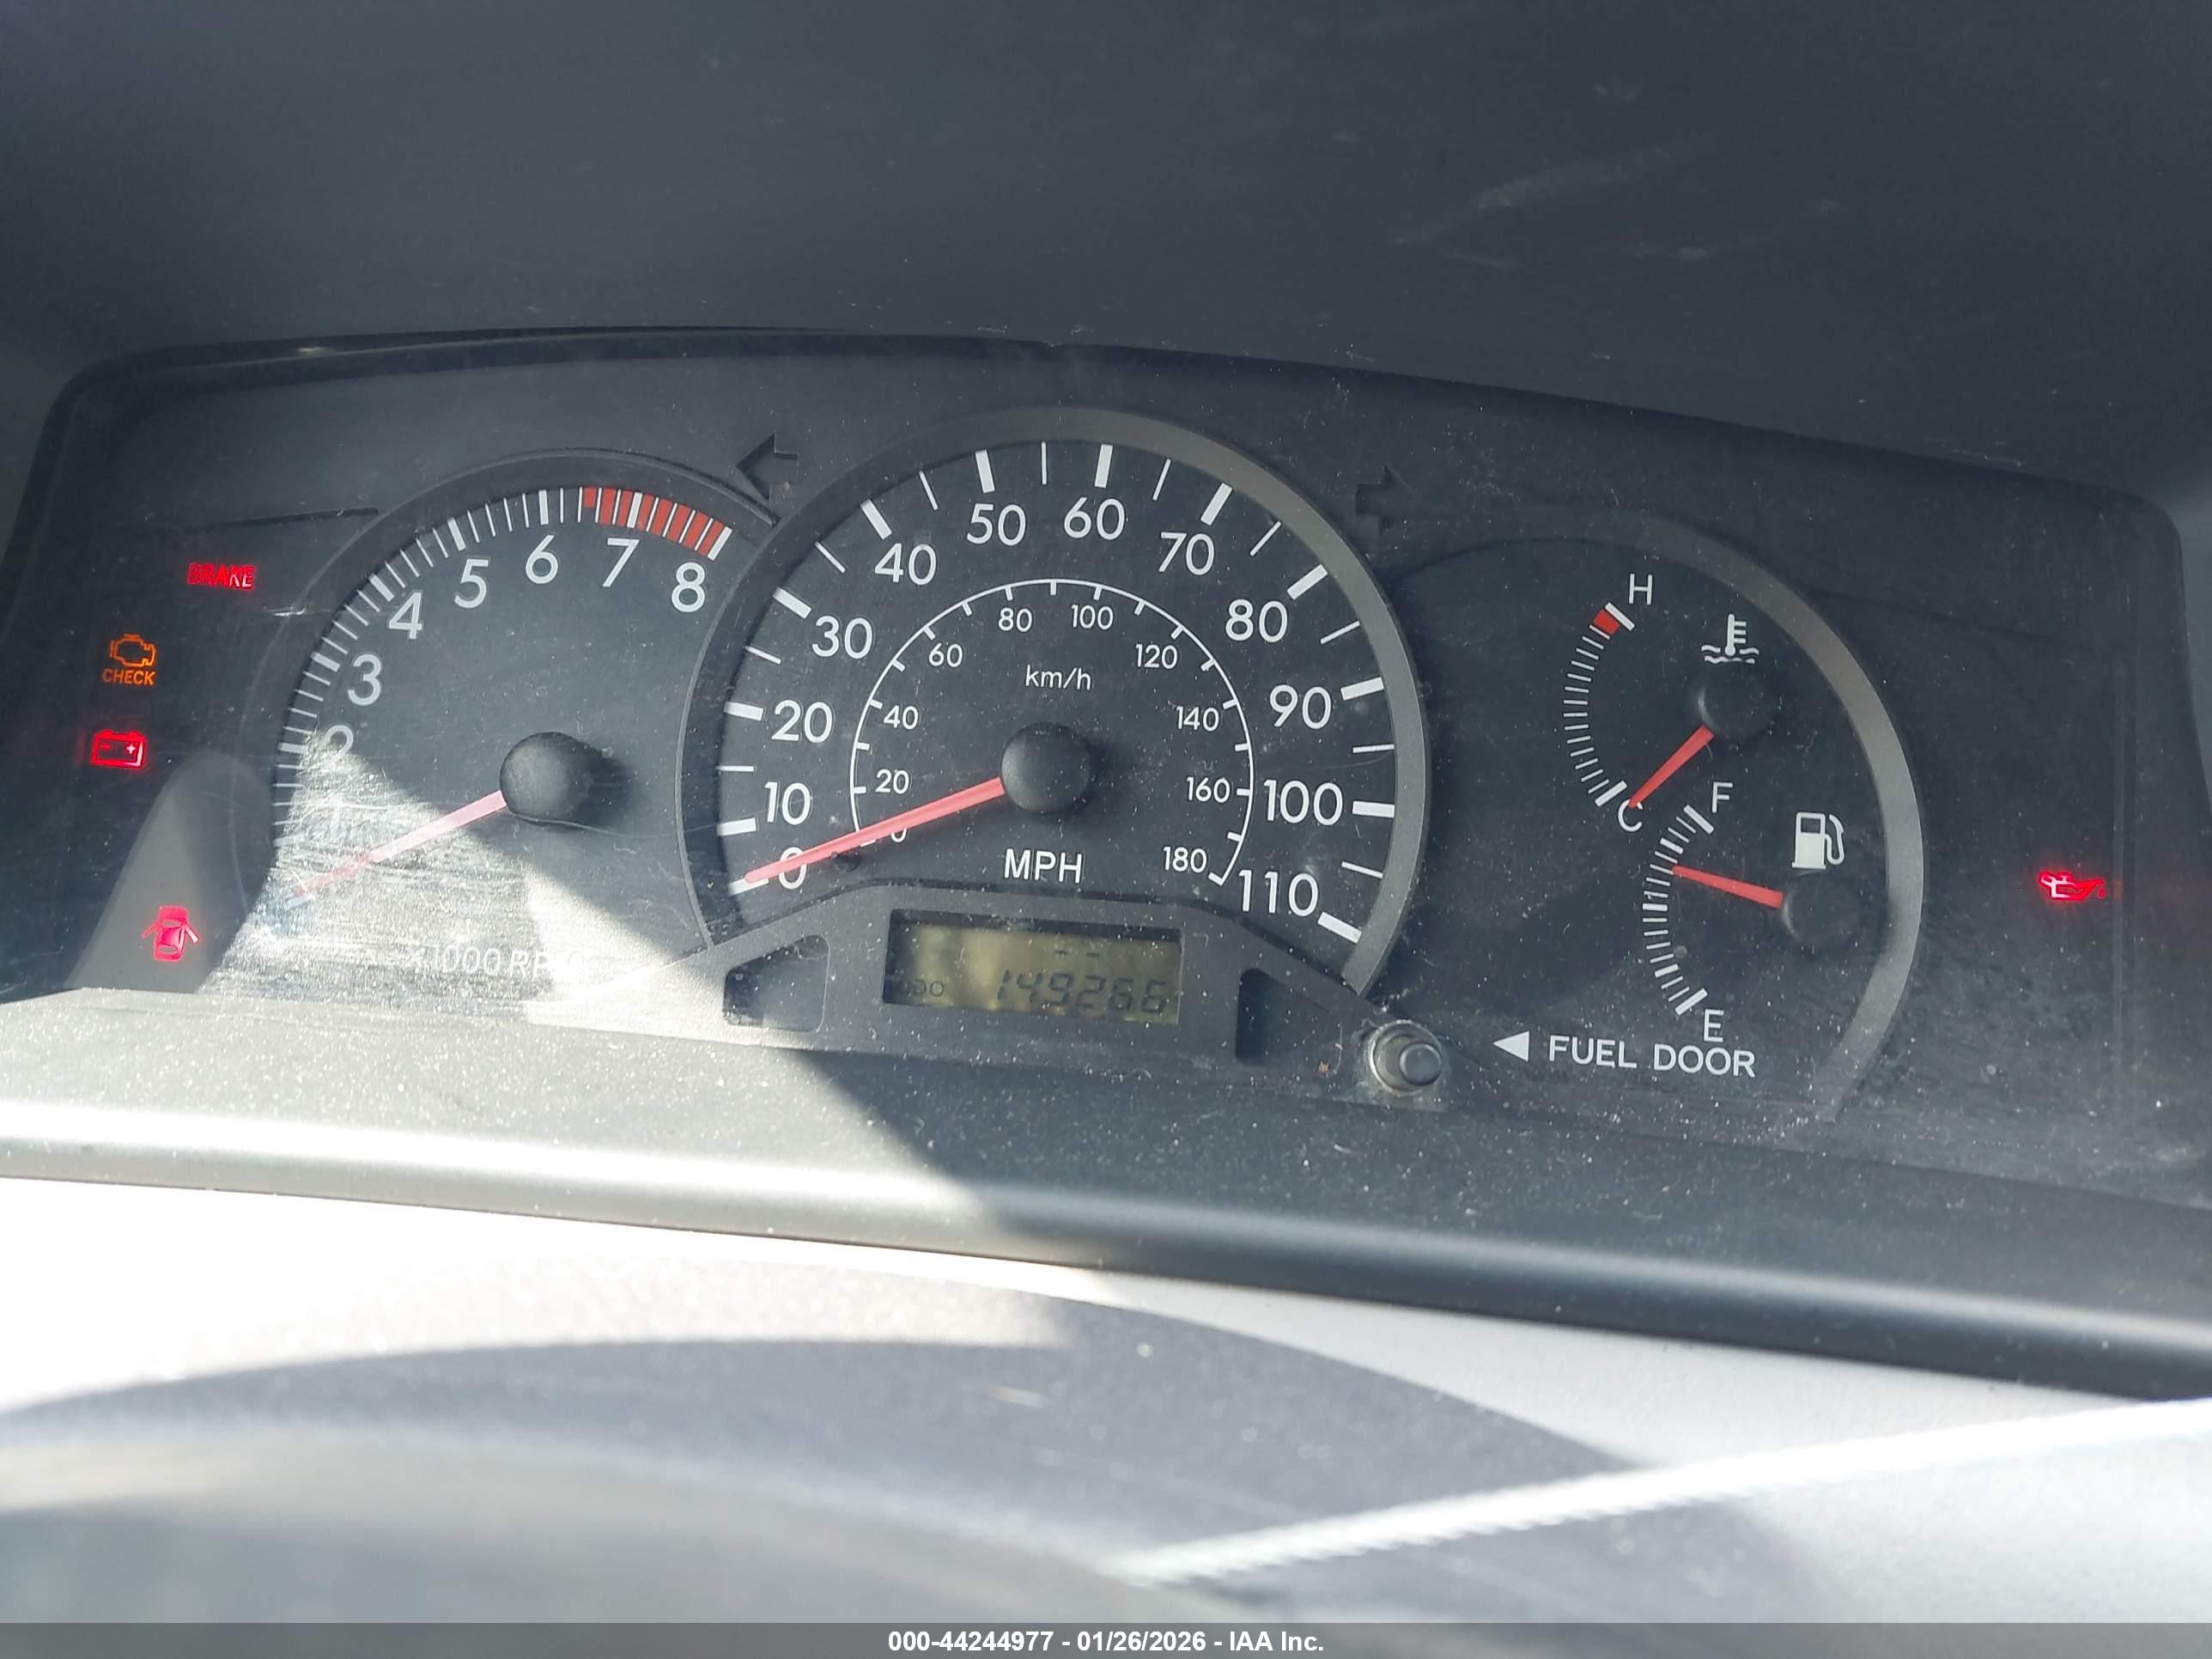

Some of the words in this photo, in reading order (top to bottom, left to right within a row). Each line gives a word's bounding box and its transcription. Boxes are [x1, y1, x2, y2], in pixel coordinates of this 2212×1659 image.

[966, 503, 1026, 546] 50
[1064, 496, 1125, 540] 60
[525, 534, 559, 585] 6
[603, 537, 640, 587] 7
[874, 543, 937, 586] 40
[1158, 532, 1215, 575] 70
[188, 563, 255, 588] BRAKE
[454, 558, 489, 609] 5
[671, 562, 706, 613] 8
[1628, 573, 1653, 605] H
[388, 591, 423, 640] 4
[811, 615, 872, 659] 30
[998, 607, 1032, 632] 80
[1071, 604, 1114, 630] 100
[1225, 599, 1288, 643] 80
[928, 642, 963, 668] 60
[1135, 643, 1178, 670] 120
[102, 668, 155, 686] CHECK
[347, 653, 382, 707] 3
[1025, 664, 1091, 690] km/h
[771, 699, 833, 744] 20
[883, 705, 919, 730] 40
[1176, 706, 1219, 732] 140
[1269, 684, 1332, 730] 90
[764, 781, 813, 825] 10
[875, 769, 909, 794] 20
[1186, 776, 1231, 803] 160
[1263, 779, 1343, 826] 100
[1711, 781, 1734, 813] F
[1618, 799, 1644, 832] C
[775, 846, 810, 890] 0
[1004, 848, 1082, 884] MPH
[1163, 846, 1207, 873] 180
[1238, 869, 1319, 917] 110
[996, 969, 1169, 1015] 149266
[1703, 1008, 1724, 1043] E
[1549, 1035, 1638, 1069] FUEL
[1653, 1042, 1756, 1078] DOOR
